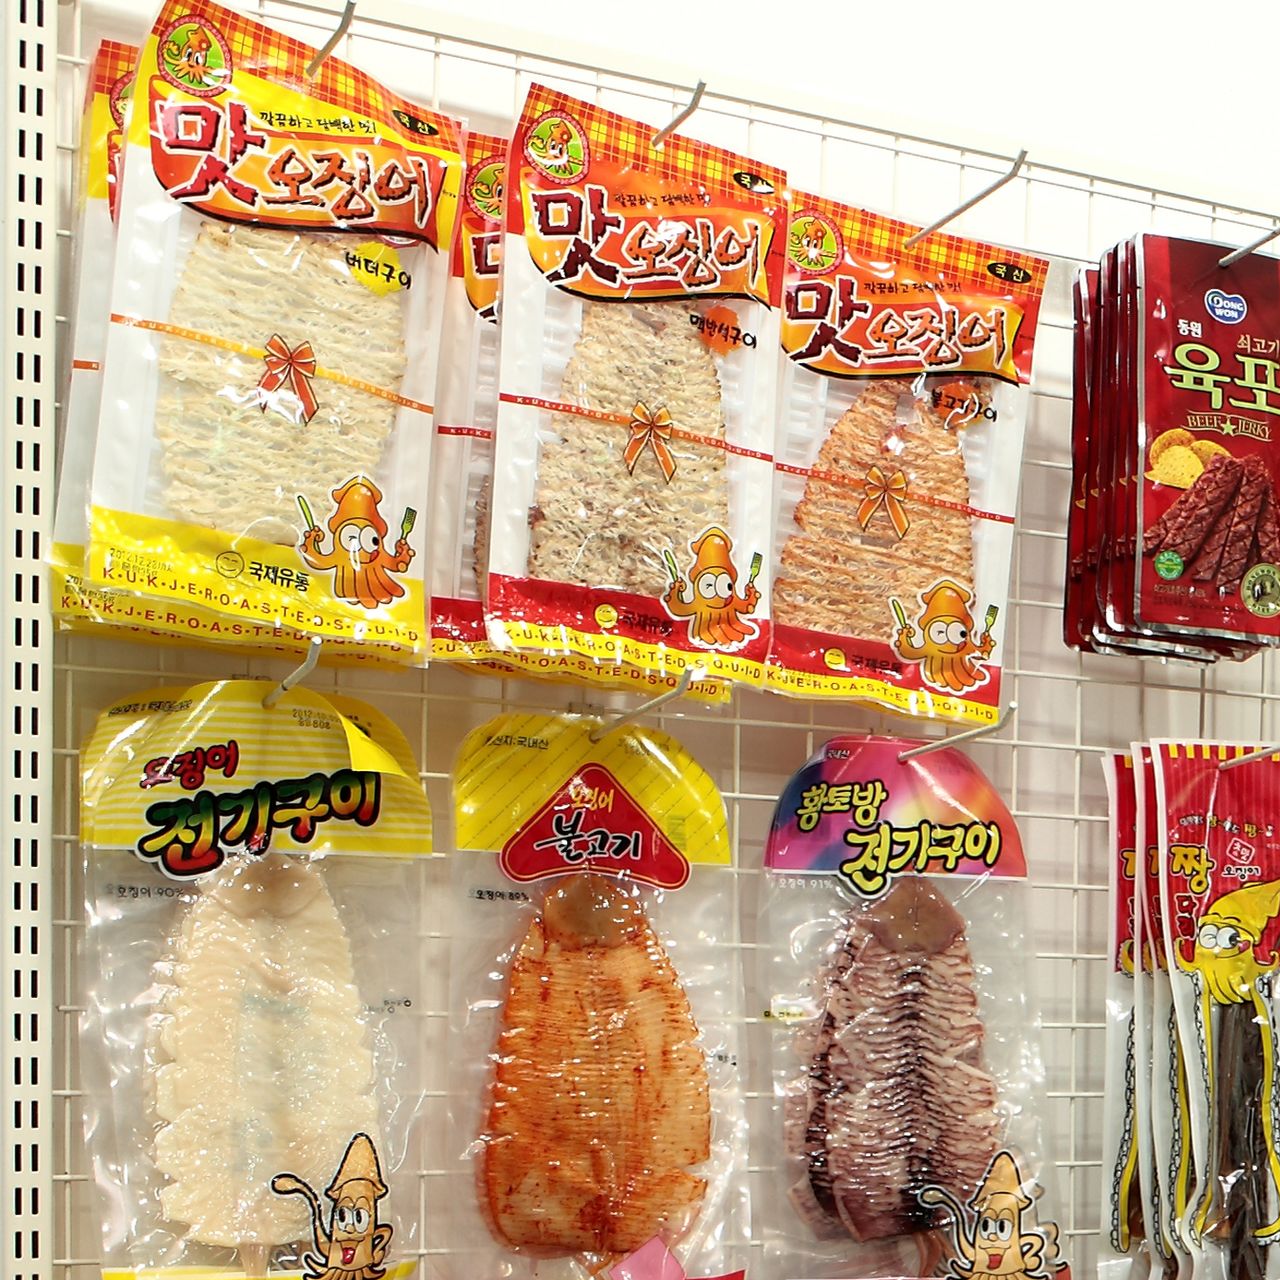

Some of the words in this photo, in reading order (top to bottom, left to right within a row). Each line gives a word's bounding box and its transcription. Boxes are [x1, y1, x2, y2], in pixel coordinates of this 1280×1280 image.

[1210, 294, 1245, 312] DONG
[1214, 306, 1240, 320] WON
[1176, 317, 1203, 339] 동원
[1236, 333, 1280, 356] 쇠고기
[1186, 413, 1222, 429] BEEF
[1236, 418, 1273, 440] JERKY
[247, 560, 312, 594] 국제유통
[139, 739, 241, 791] 오징어
[794, 779, 890, 832] 황토방
[134, 768, 382, 881] 전기구이
[533, 808, 643, 863] 불고기
[839, 818, 1003, 897] 전기구이
[1169, 844, 1215, 895] 짱
[1221, 866, 1261, 880] 오징어
[156, 886, 185, 899] 90%
